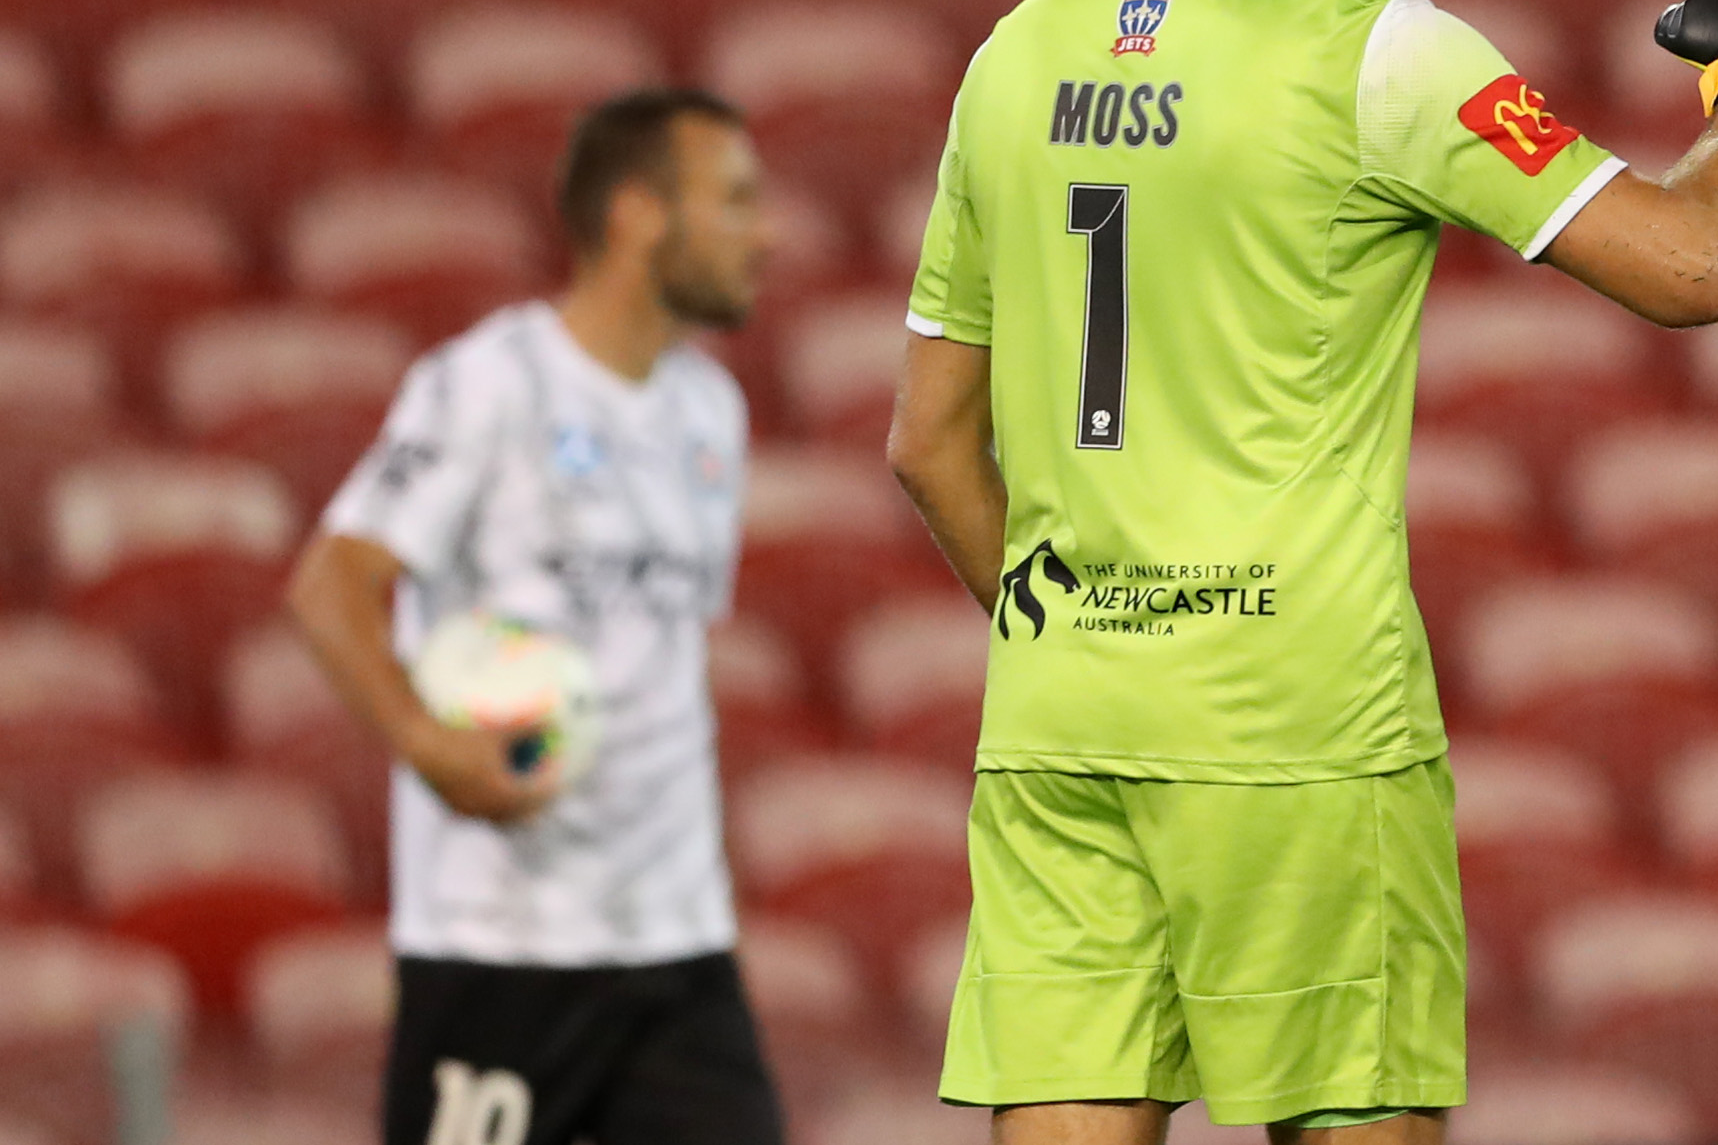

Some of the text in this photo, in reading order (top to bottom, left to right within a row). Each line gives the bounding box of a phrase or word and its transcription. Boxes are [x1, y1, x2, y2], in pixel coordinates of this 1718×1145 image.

[1117, 37, 1152, 52] JETS
[1048, 80, 1184, 149] MOSS
[1066, 182, 1129, 451] 1
[1083, 563, 1277, 579] THE UNIVERSITY OF
[1081, 585, 1277, 616] NEWCASTLE
[1072, 616, 1175, 636] AUSTRALIA
[427, 1058, 534, 1145] 10
